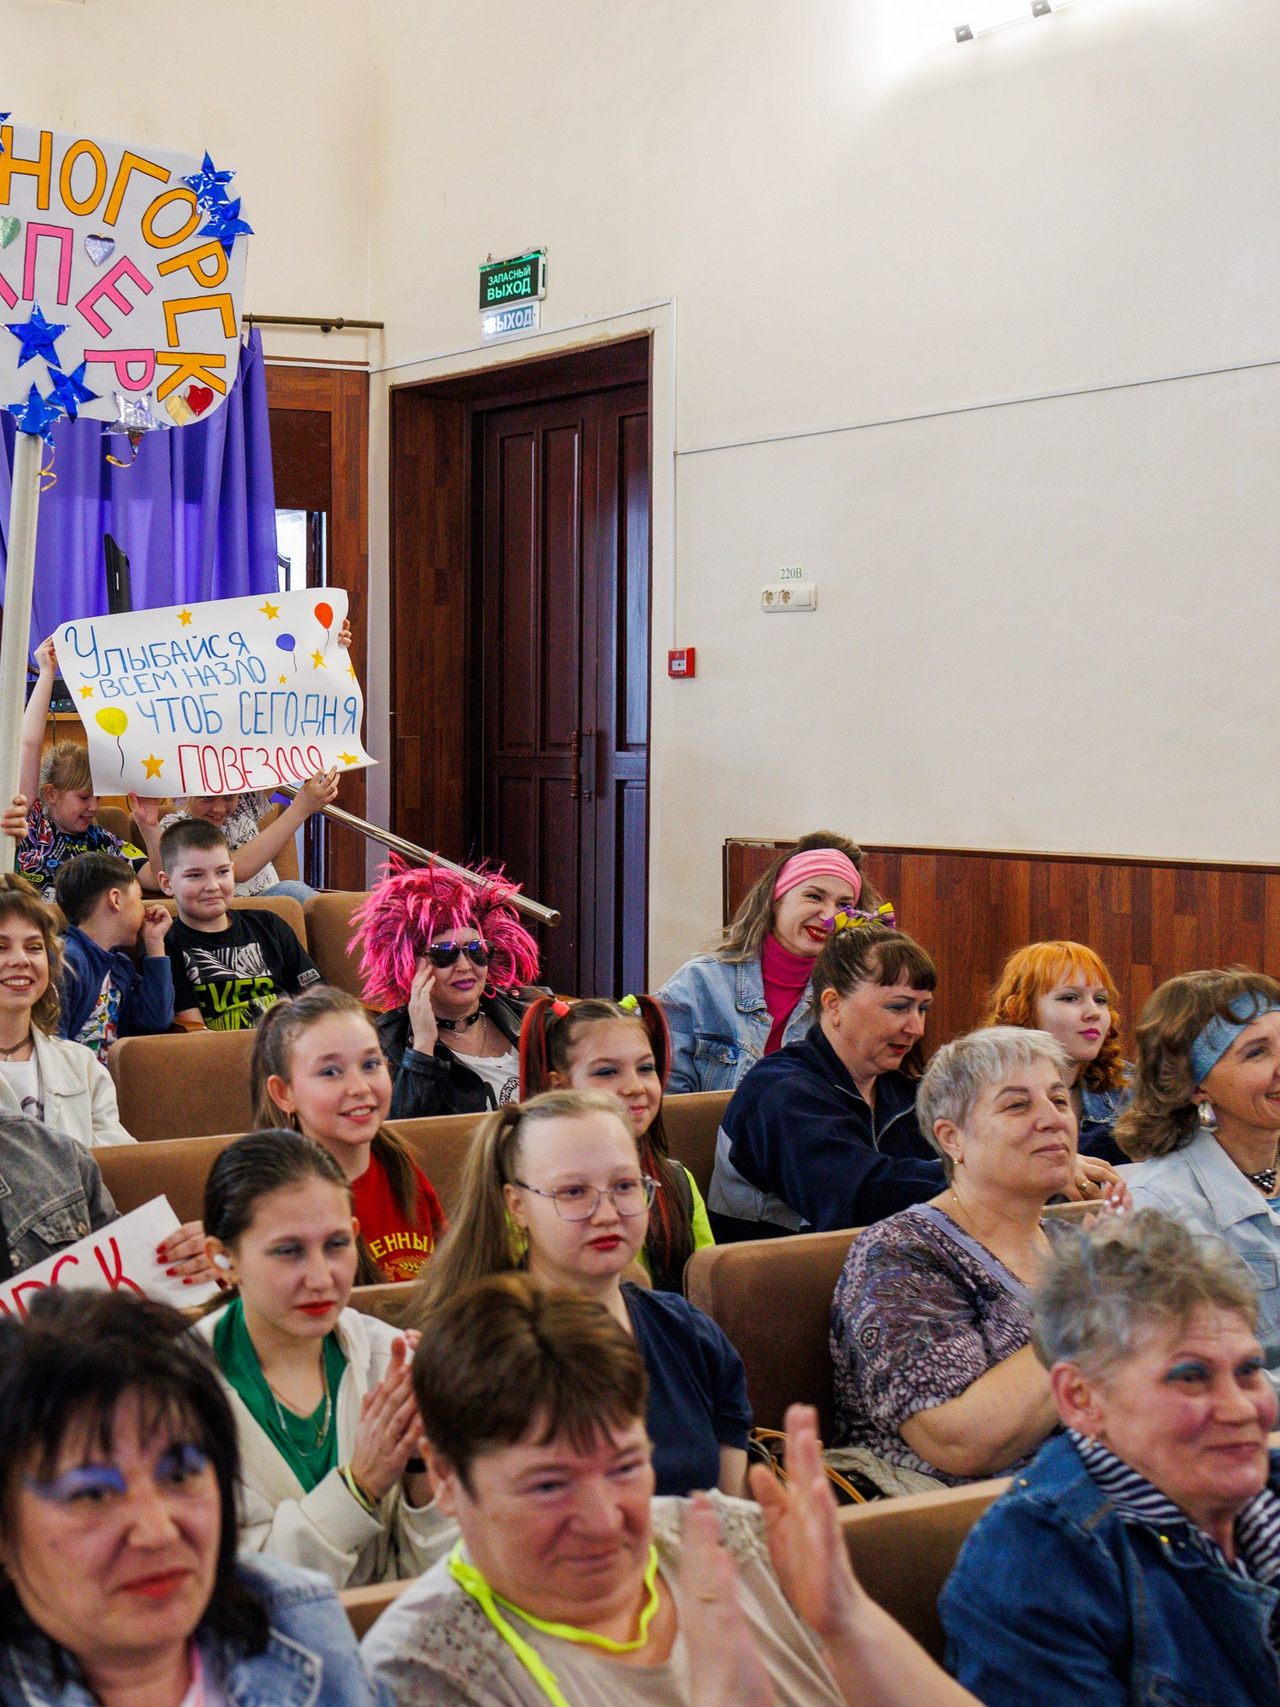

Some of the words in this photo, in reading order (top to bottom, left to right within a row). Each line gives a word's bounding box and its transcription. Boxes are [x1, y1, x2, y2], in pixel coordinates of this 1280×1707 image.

[488, 264, 531, 286] ЗАПАСНЫЙ
[487, 277, 531, 301] ВЫХОД
[487, 308, 532, 334] ВЫХОД
[780, 567, 803, 580] 220В
[64, 625, 250, 679] УЛЫБАЙСЯ
[99, 670, 178, 699] ВСЕМ
[182, 656, 267, 689] НАЗЛО
[136, 692, 223, 735] ЧТОБ
[239, 691, 358, 737] СЕГОДНЯ
